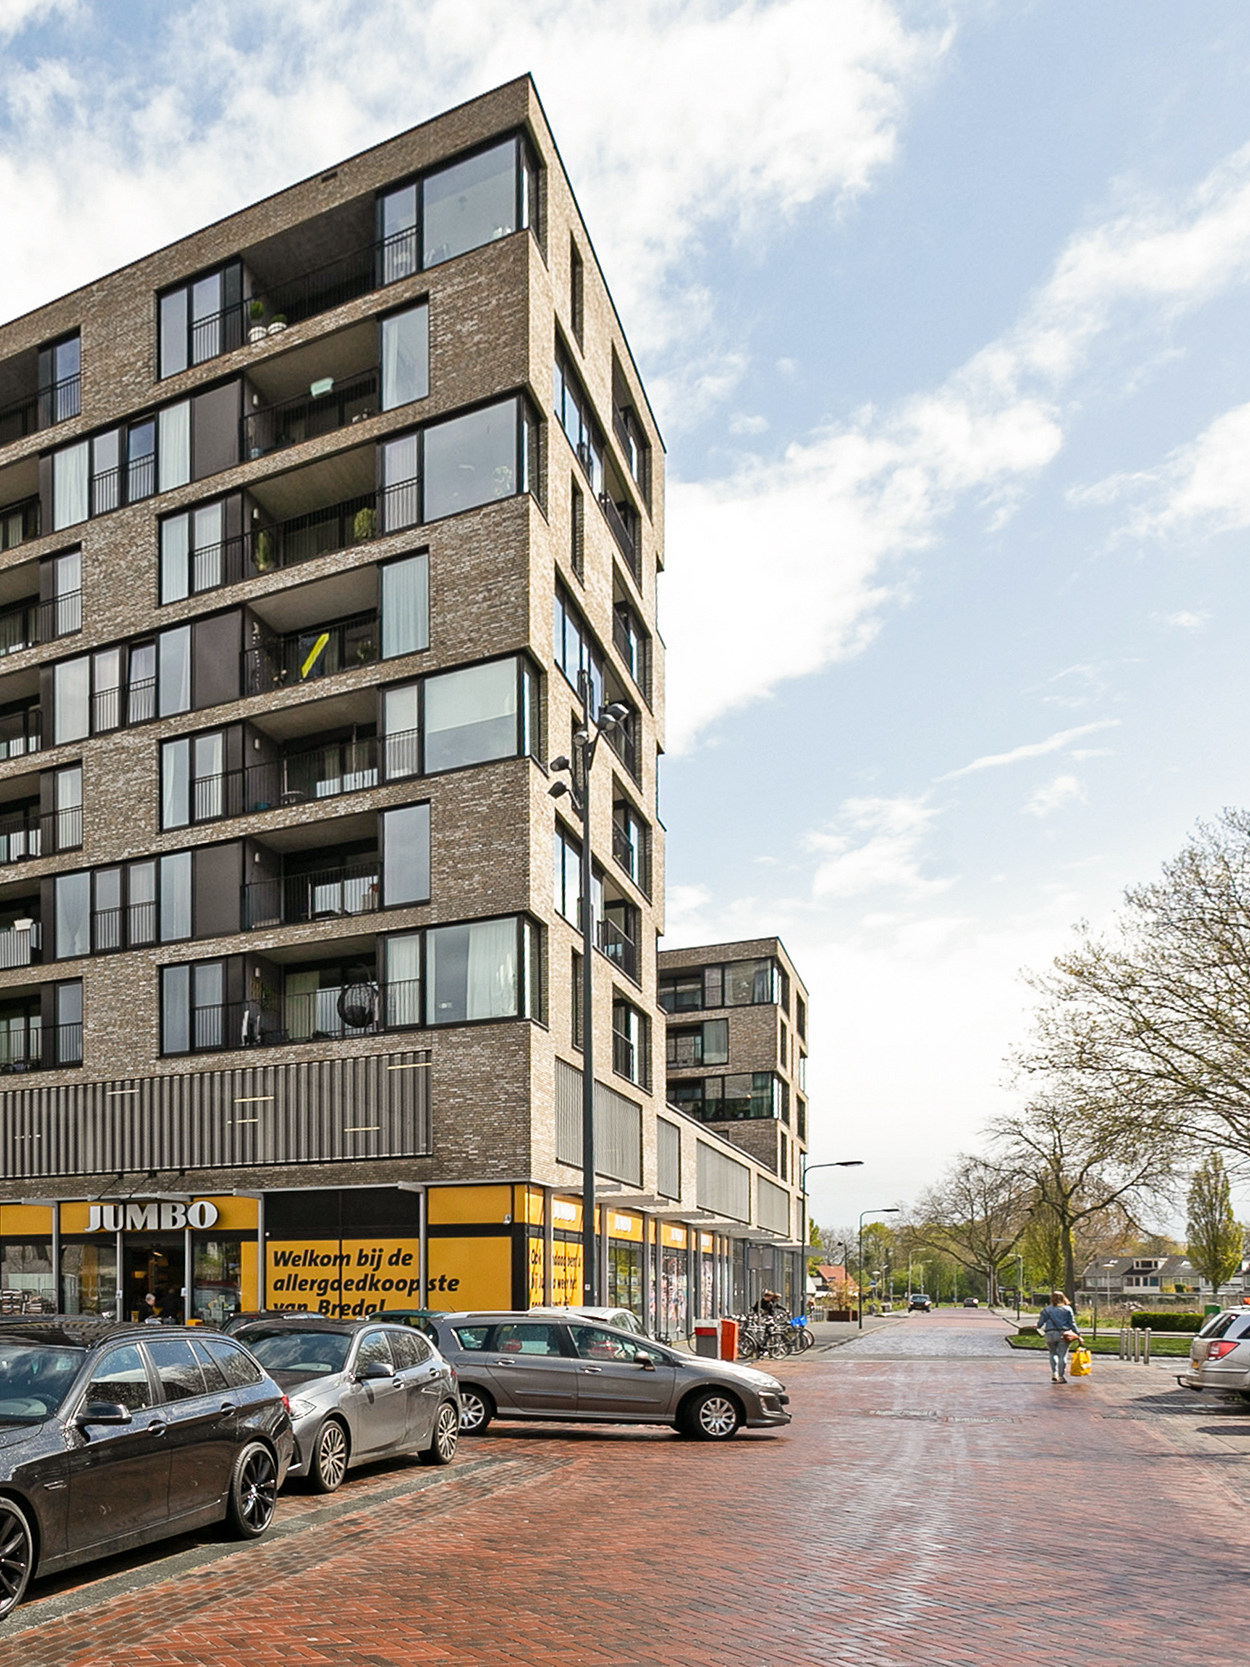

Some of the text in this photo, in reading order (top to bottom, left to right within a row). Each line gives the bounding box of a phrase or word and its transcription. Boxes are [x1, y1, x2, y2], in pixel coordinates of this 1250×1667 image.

[84, 1200, 218, 1232] JUMBO
[273, 1248, 413, 1271] Welkom bij de
[273, 1274, 460, 1297] allergoedkoopste
